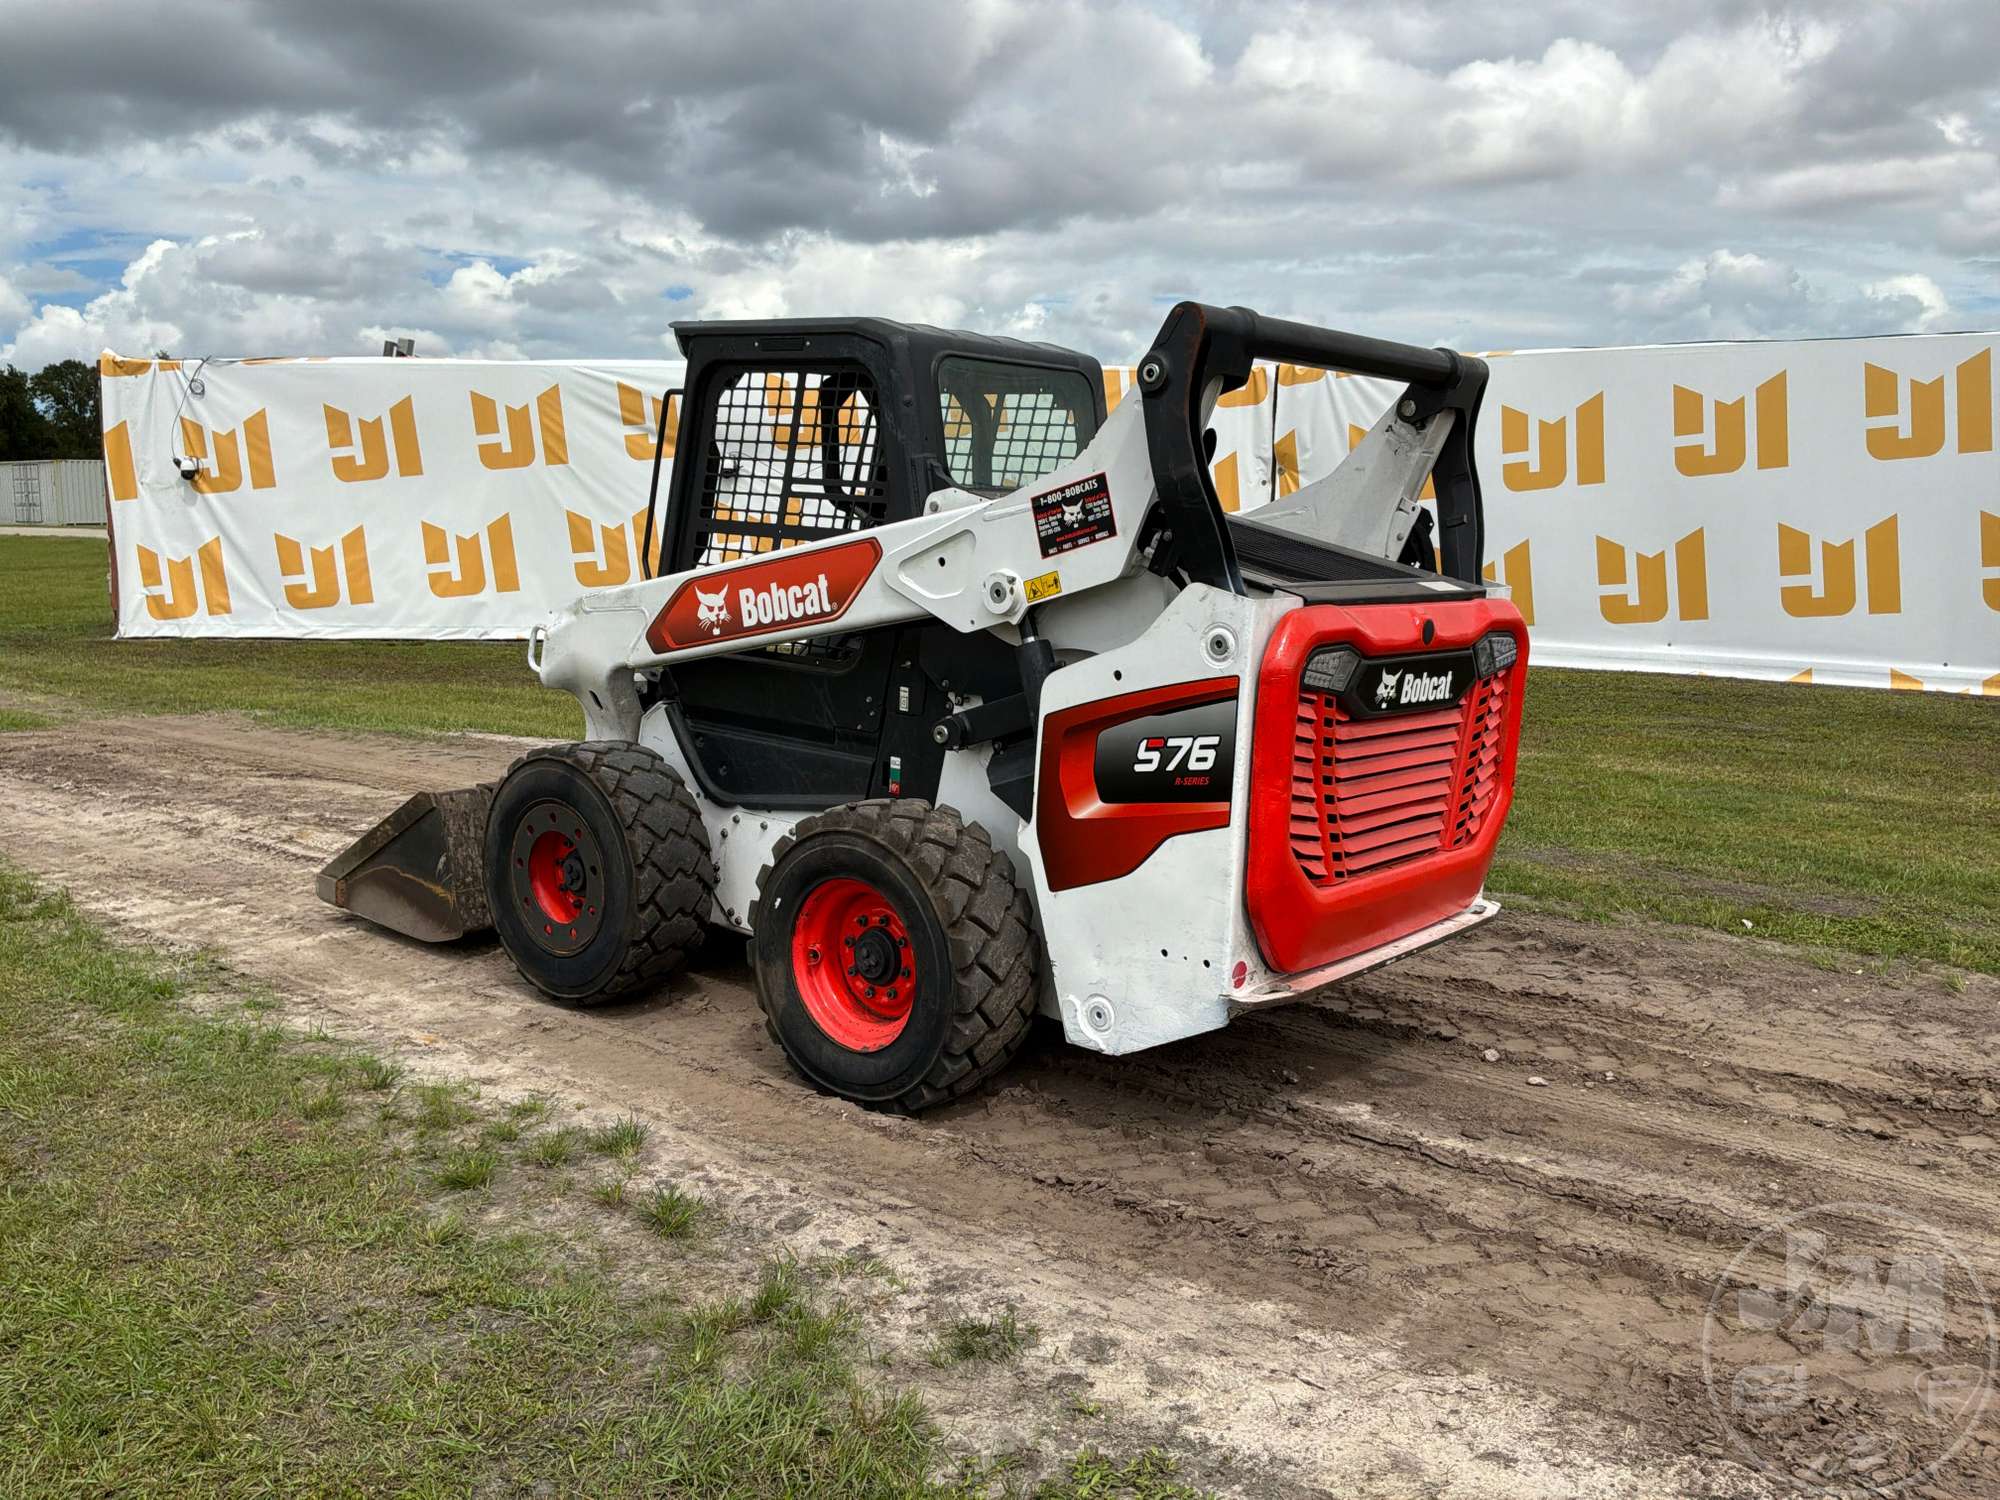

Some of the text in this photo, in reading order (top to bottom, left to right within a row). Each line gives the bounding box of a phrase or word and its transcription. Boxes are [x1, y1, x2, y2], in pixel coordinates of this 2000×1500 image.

[1039, 478, 1098, 506] 1-800-BOBCATS
[739, 574, 832, 628] Bobcat
[1400, 670, 1453, 704] Bobcat
[1133, 736, 1220, 772] S76
[1174, 776, 1210, 786] R-SERIES
